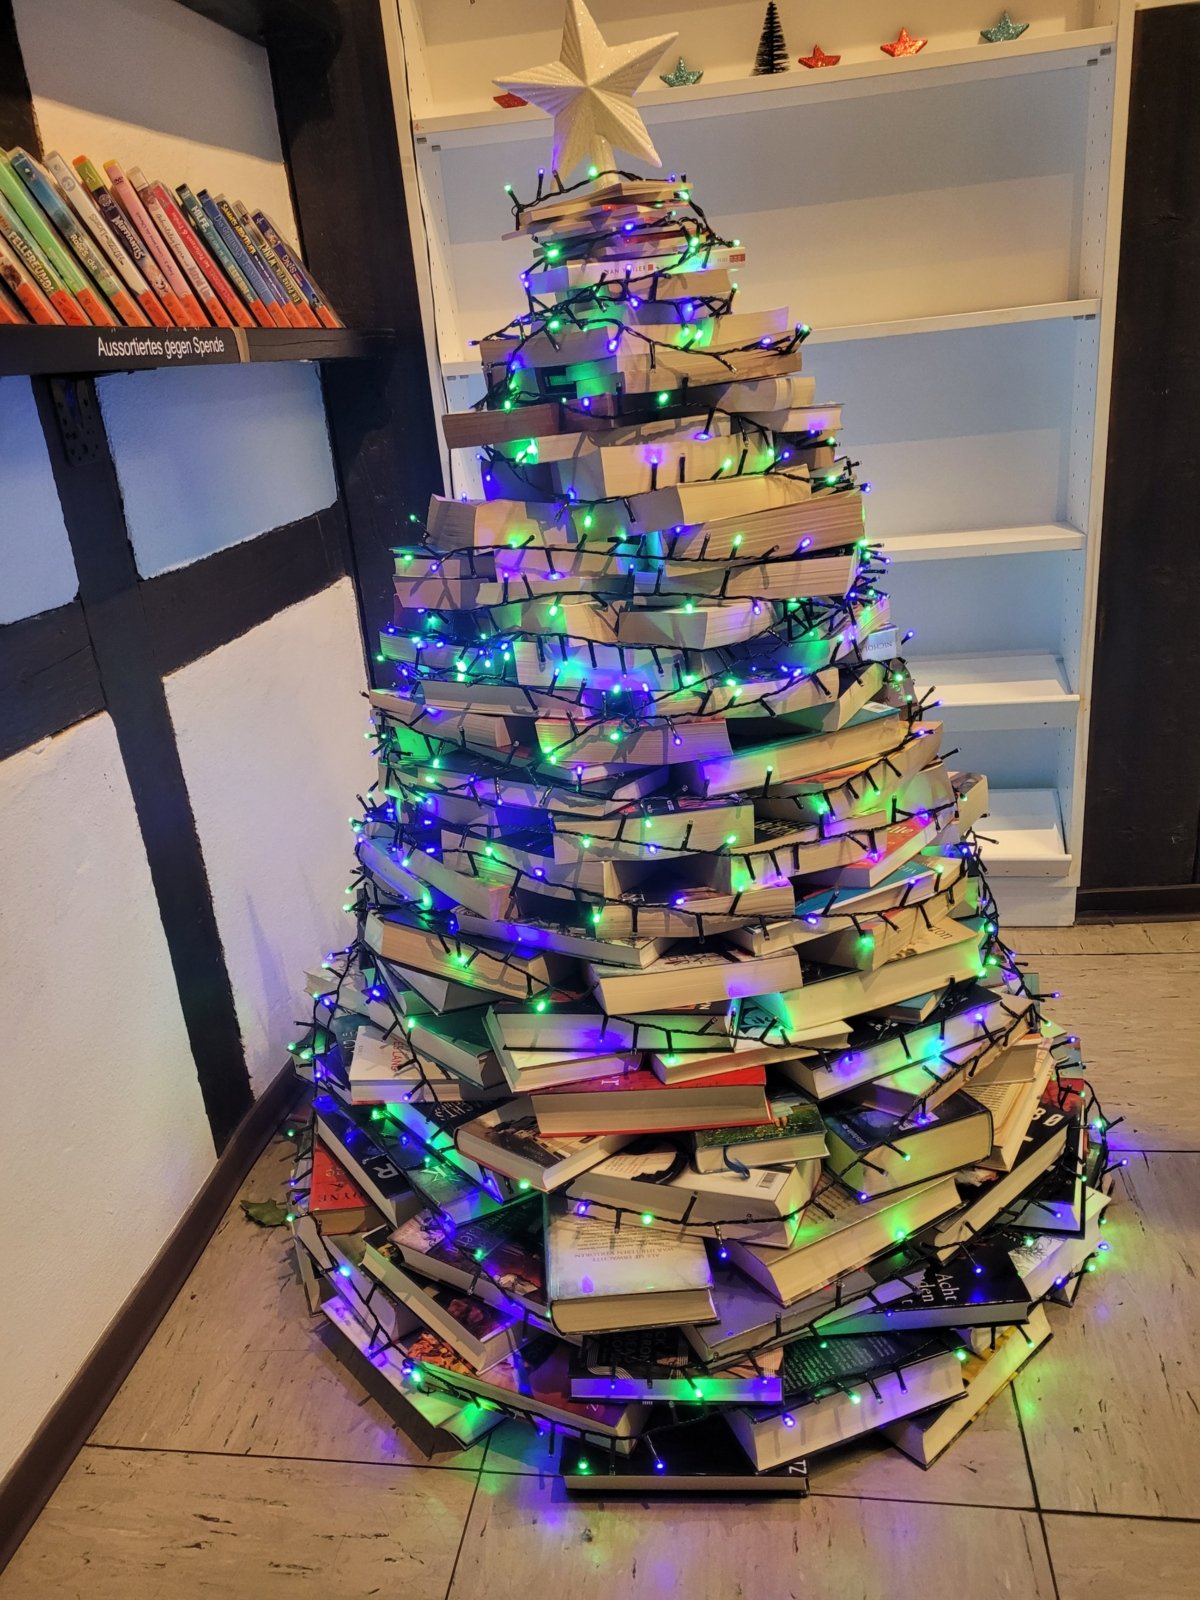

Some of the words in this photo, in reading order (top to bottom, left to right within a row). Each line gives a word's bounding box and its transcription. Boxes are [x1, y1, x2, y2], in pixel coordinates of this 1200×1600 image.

[189, 205, 211, 233] HILFE,
[98, 336, 163, 356] Aussortiertes
[164, 339, 192, 359] gegen
[193, 336, 224, 357] Spende
[919, 1279, 935, 1303] den
[935, 1273, 960, 1301] Acht
